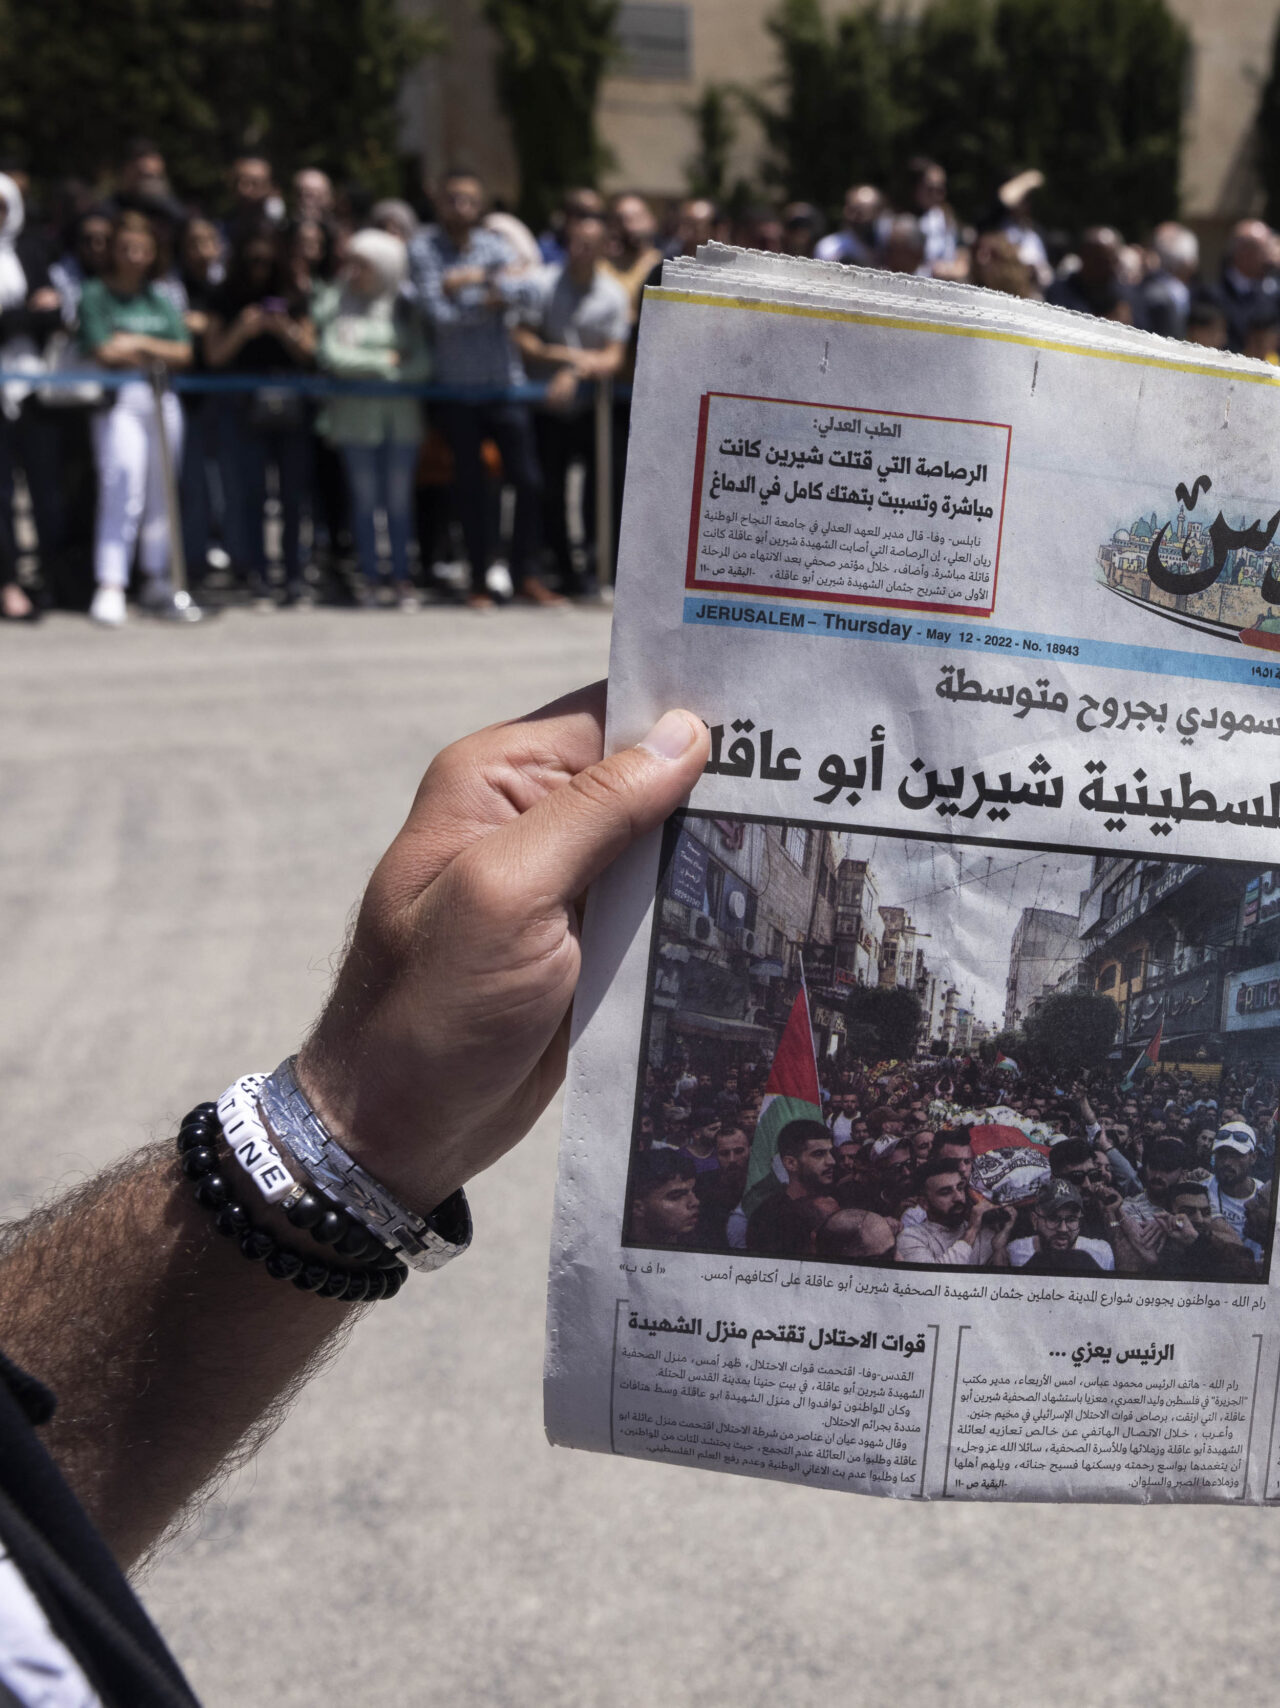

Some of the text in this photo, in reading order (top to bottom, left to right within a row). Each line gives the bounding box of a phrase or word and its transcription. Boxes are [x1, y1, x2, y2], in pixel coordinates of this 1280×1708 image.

[813, 417, 901, 440] الطب العدلي:
[719, 438, 987, 486] الرصاصة التي قتلت شيرين كانت
[709, 470, 993, 522] مباشرة وتسببت بتهتك كامل في الدماغ
[696, 605, 805, 627] JERUSALEM
[823, 613, 912, 640] Thursday
[927, 629, 951, 643] May
[960, 632, 973, 643] 12
[984, 635, 1012, 647] 2022
[1023, 640, 1041, 651] No.
[1047, 643, 1079, 656] 18943
[936, 668, 1068, 719] متوسطة
[1076, 694, 1167, 733] بجروح
[814, 725, 884, 806] أبو
[898, 754, 1063, 821] شيرين
[701, 1270, 1266, 1311] رام الله مواطنون يجوبون شوارع المدينة حاملين جثمان الشهيدة الصحفية شيرين أبو عاقلة على أكتافهم أمس.
[628, 1312, 925, 1358] قوات الاحتلال تقتحم منزل الشهيدة
[1071, 1342, 1112, 1367] يعزي
[1116, 1342, 1174, 1366] الرئيس
